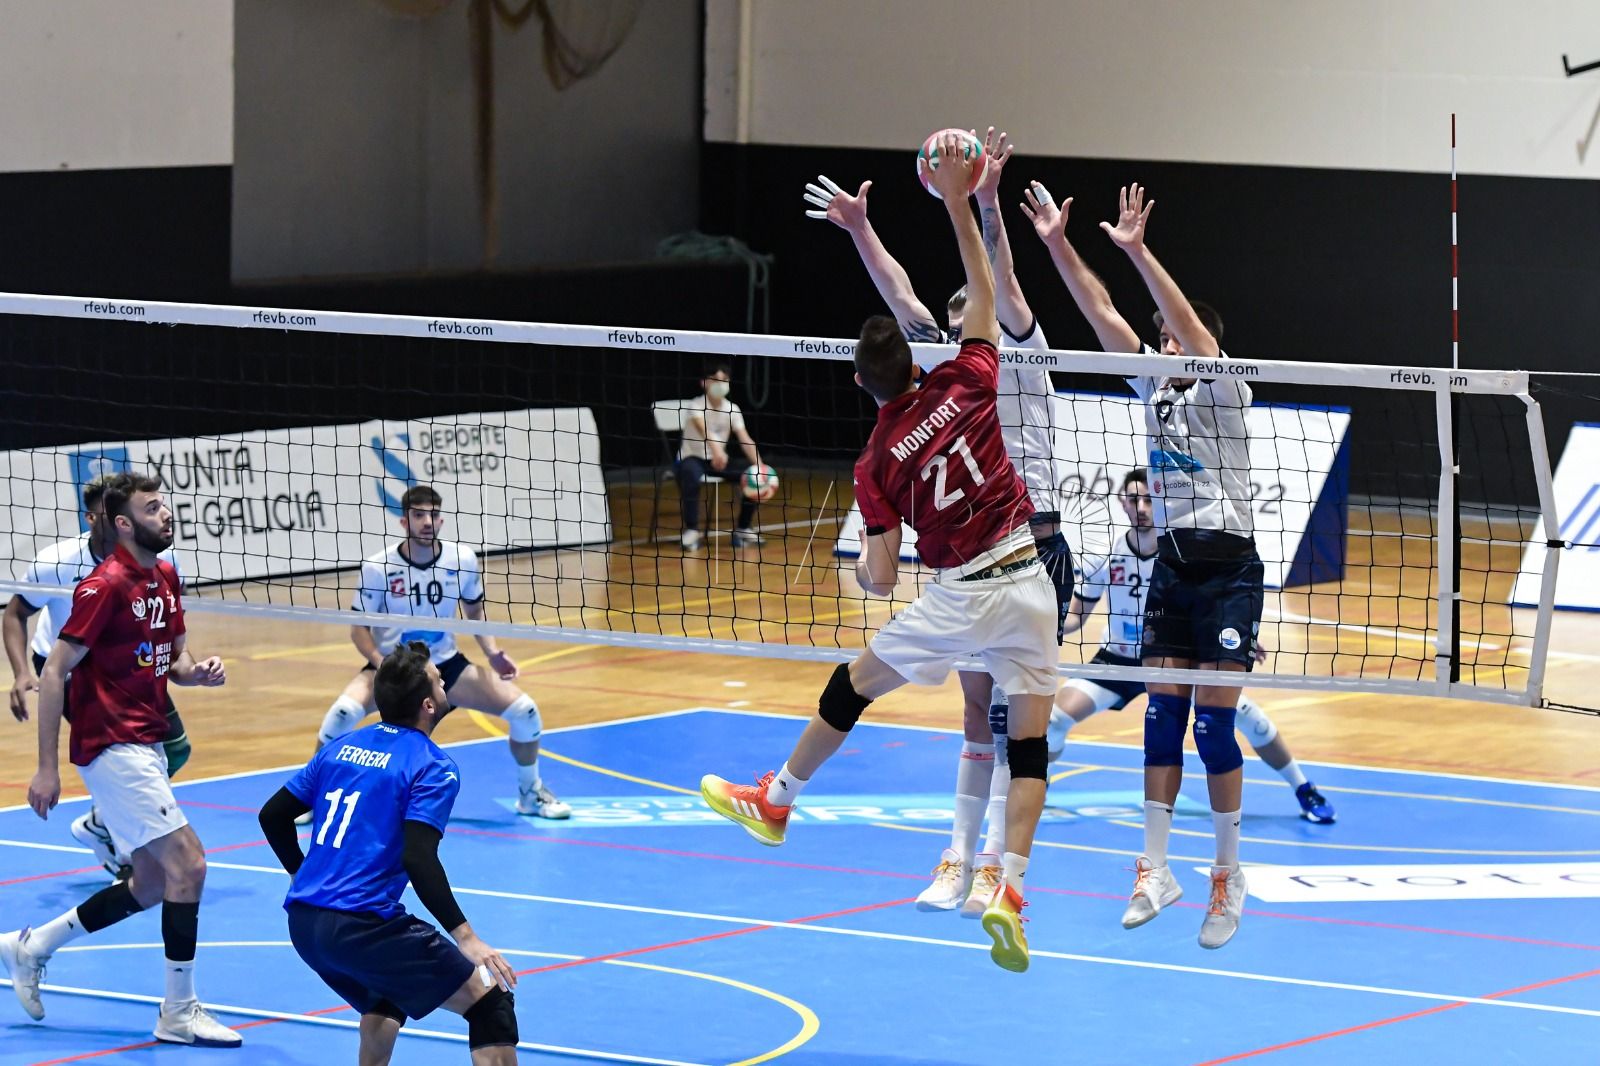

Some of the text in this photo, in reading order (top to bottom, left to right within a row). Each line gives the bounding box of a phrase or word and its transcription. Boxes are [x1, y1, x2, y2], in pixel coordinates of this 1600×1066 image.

[84, 301, 146, 316] rfevb.com
[252, 311, 317, 326] rfevb.com
[427, 321, 493, 336] rfevb.com
[608, 330, 676, 346] rfevb.com
[998, 351, 1058, 366] evb.com
[1184, 360, 1259, 376] rfevb.com
[1390, 369, 1468, 387] rfevb.m
[419, 426, 504, 450] DEPORTE
[890, 396, 962, 463] MONFORT
[147, 447, 254, 491] XUNTA
[423, 451, 500, 476] GALEGO
[920, 434, 986, 512] 21
[202, 490, 326, 539] GALICIA
[411, 580, 443, 606] 10
[1128, 573, 1151, 598] 2
[147, 596, 166, 629] 22
[336, 744, 392, 769] FERRERA
[316, 788, 361, 849] 11
